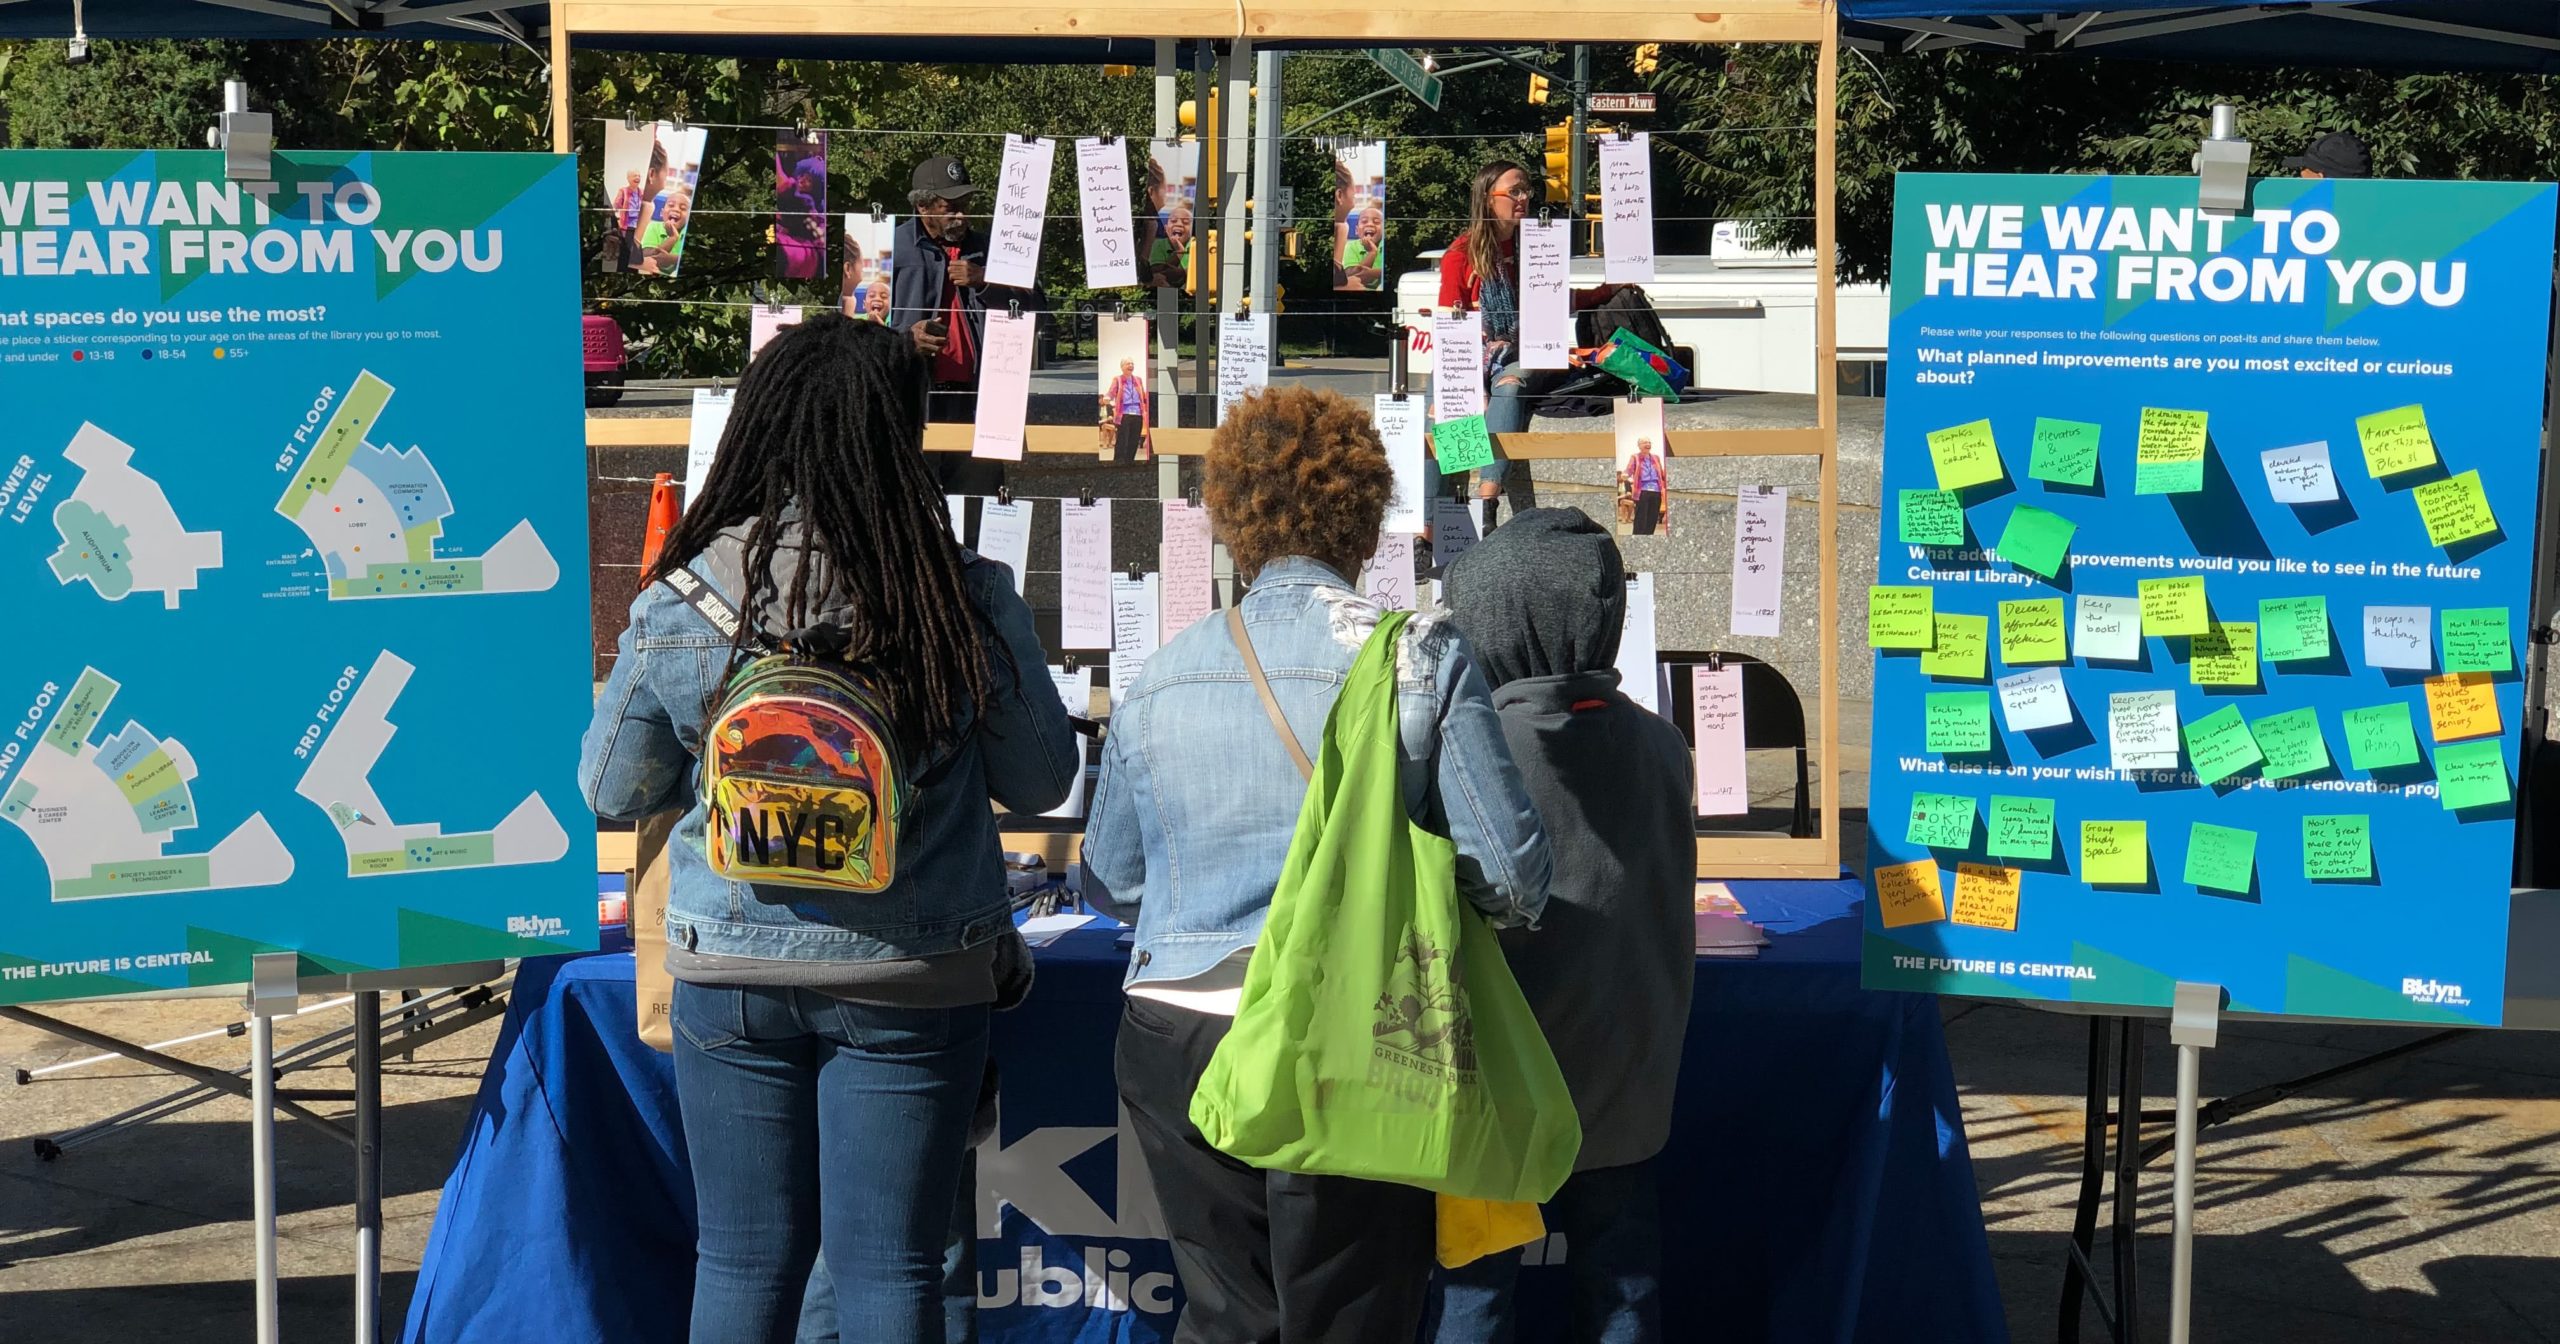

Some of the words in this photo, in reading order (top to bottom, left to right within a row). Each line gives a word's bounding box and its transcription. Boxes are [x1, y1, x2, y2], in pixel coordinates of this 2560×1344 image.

[1591, 96, 1625, 109] Eastern
[1629, 96, 1654, 110] Pkwy
[86, 181, 280, 226] WANT
[297, 181, 381, 226] TO
[1008, 184, 1030, 199] THE
[1925, 203, 2024, 250] WE
[2041, 205, 2236, 253] WANT
[2253, 210, 2340, 257] TO
[170, 229, 354, 275] FROM
[371, 229, 503, 274] YOU
[1924, 252, 2098, 300] HEAR
[2116, 256, 2306, 303] FROM
[2325, 261, 2467, 307] YOU
[0, 309, 29, 326] at
[34, 311, 106, 329] spaces
[111, 308, 138, 325] do
[142, 310, 181, 328] you
[186, 309, 223, 324] use
[227, 306, 261, 322] the
[266, 305, 327, 322] most?
[12, 335, 41, 346] place
[44, 336, 50, 344] a
[53, 334, 88, 345] sticker
[91, 333, 168, 345] corresponding
[170, 334, 181, 343] to
[183, 334, 207, 345] your
[209, 334, 229, 344] age
[232, 332, 246, 341] on
[248, 330, 265, 341] the
[267, 332, 296, 341] areas
[299, 330, 310, 340] of
[311, 330, 328, 340] the
[330, 330, 362, 342] library
[364, 331, 384, 342] you
[386, 331, 400, 342] go
[402, 330, 412, 340] to
[414, 329, 442, 340] most.
[1920, 326, 1955, 338] Please
[1957, 327, 1983, 338] write
[1985, 329, 2009, 340] your
[2011, 329, 2064, 340] responses
[2067, 330, 2078, 340] to
[2080, 330, 2097, 340] the
[2099, 330, 2147, 343] following
[2149, 332, 2200, 344] questions
[2203, 334, 2217, 343] on
[2219, 333, 2258, 345] post-its
[2261, 334, 2281, 344] and
[2283, 334, 2313, 345] share
[2316, 335, 2343, 346] them
[2345, 335, 2381, 347] below.
[5, 352, 27, 362] and
[28, 351, 60, 362] under
[89, 351, 115, 361] 13-18
[158, 350, 187, 360] 18-54
[229, 348, 250, 359] 55+
[1917, 348, 1963, 364] What
[1967, 350, 2038, 366] planned
[2043, 351, 2169, 370] improvements
[2173, 358, 2202, 369] are
[2206, 358, 2240, 373] you
[2244, 358, 2290, 372] most
[2294, 356, 2359, 373] excited
[2363, 361, 2382, 374] or
[2386, 359, 2454, 376] curious
[1916, 369, 1976, 385] about?
[275, 443, 299, 474] 1ST
[293, 385, 338, 444] FLOOR
[10, 473, 53, 524] LEVEL
[2418, 482, 2460, 498] Meeting
[348, 521, 368, 529] LOBBY
[81, 530, 113, 574] AUDITORIUM
[1908, 545, 1954, 562] What
[1958, 547, 2008, 563] additi
[2064, 551, 2175, 571] provements
[2179, 556, 2233, 571] would
[2237, 559, 2270, 575] you
[2275, 557, 2308, 574] like
[2312, 560, 2331, 575] to
[2334, 563, 2366, 576] see
[2370, 561, 2388, 577] in
[2392, 562, 2422, 577] the
[2426, 563, 2481, 579] future
[664, 567, 701, 596] PIN
[1907, 566, 1971, 583] Central
[1974, 569, 2043, 588] Library?
[696, 591, 741, 638] PINK
[2082, 599, 2113, 613] Keep
[2086, 620, 2121, 636] books!
[2007, 683, 2057, 698] tutoring
[15, 681, 60, 741] FLOOR
[293, 723, 321, 760] 3RD
[316, 665, 359, 723] FLOOR
[1899, 757, 1945, 774] What
[1949, 761, 1983, 776] else
[1987, 761, 2002, 776] is
[2006, 765, 2028, 778] on
[2032, 765, 2072, 782] your
[2075, 764, 2116, 782] wish
[2120, 767, 2147, 783] list
[2151, 769, 2178, 785] for
[2214, 771, 2300, 791] ong-term
[2304, 777, 2400, 795] renovation
[2405, 779, 2441, 800] proj
[2085, 823, 2114, 835] Group
[2307, 818, 2337, 828] Hours
[2335, 826, 2363, 838] great
[737, 806, 845, 872] NYC
[507, 914, 562, 937] Bklyn
[2, 965, 37, 981] THE
[41, 959, 111, 978] FUTURE
[115, 957, 131, 971] IS
[134, 950, 215, 969] CENTRAL
[1893, 955, 1926, 971] THE
[1929, 957, 1996, 975] FUTURE
[2000, 961, 2016, 976] IS
[2019, 963, 2097, 981] CENTRAL
[2402, 977, 2462, 1003] Bklyn
[1374, 1046, 1443, 1079] GREENEST
